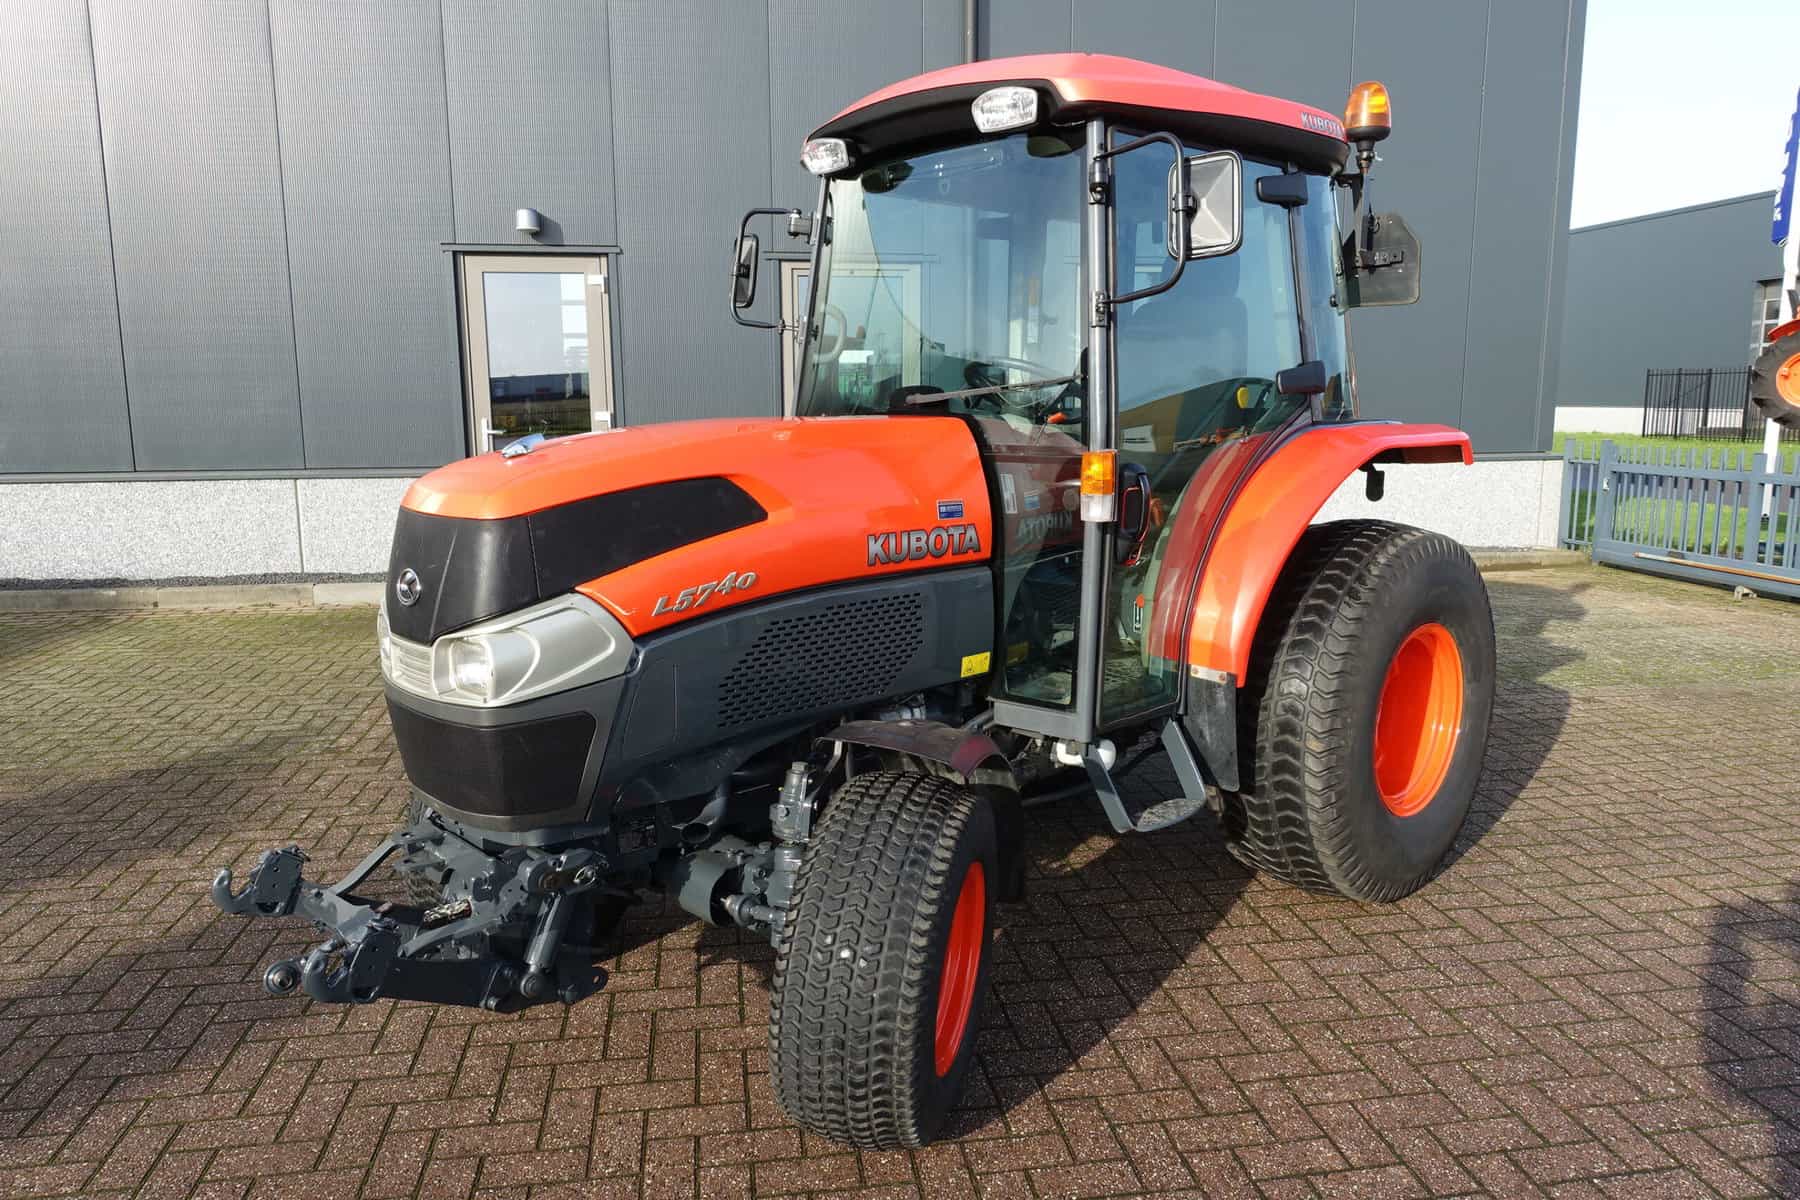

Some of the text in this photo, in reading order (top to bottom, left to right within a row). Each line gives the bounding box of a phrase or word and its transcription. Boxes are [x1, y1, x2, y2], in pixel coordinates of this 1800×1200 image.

[1301, 112, 1343, 137] KUBOTA
[867, 524, 981, 567] KUBOTA
[651, 571, 757, 617] L5740
